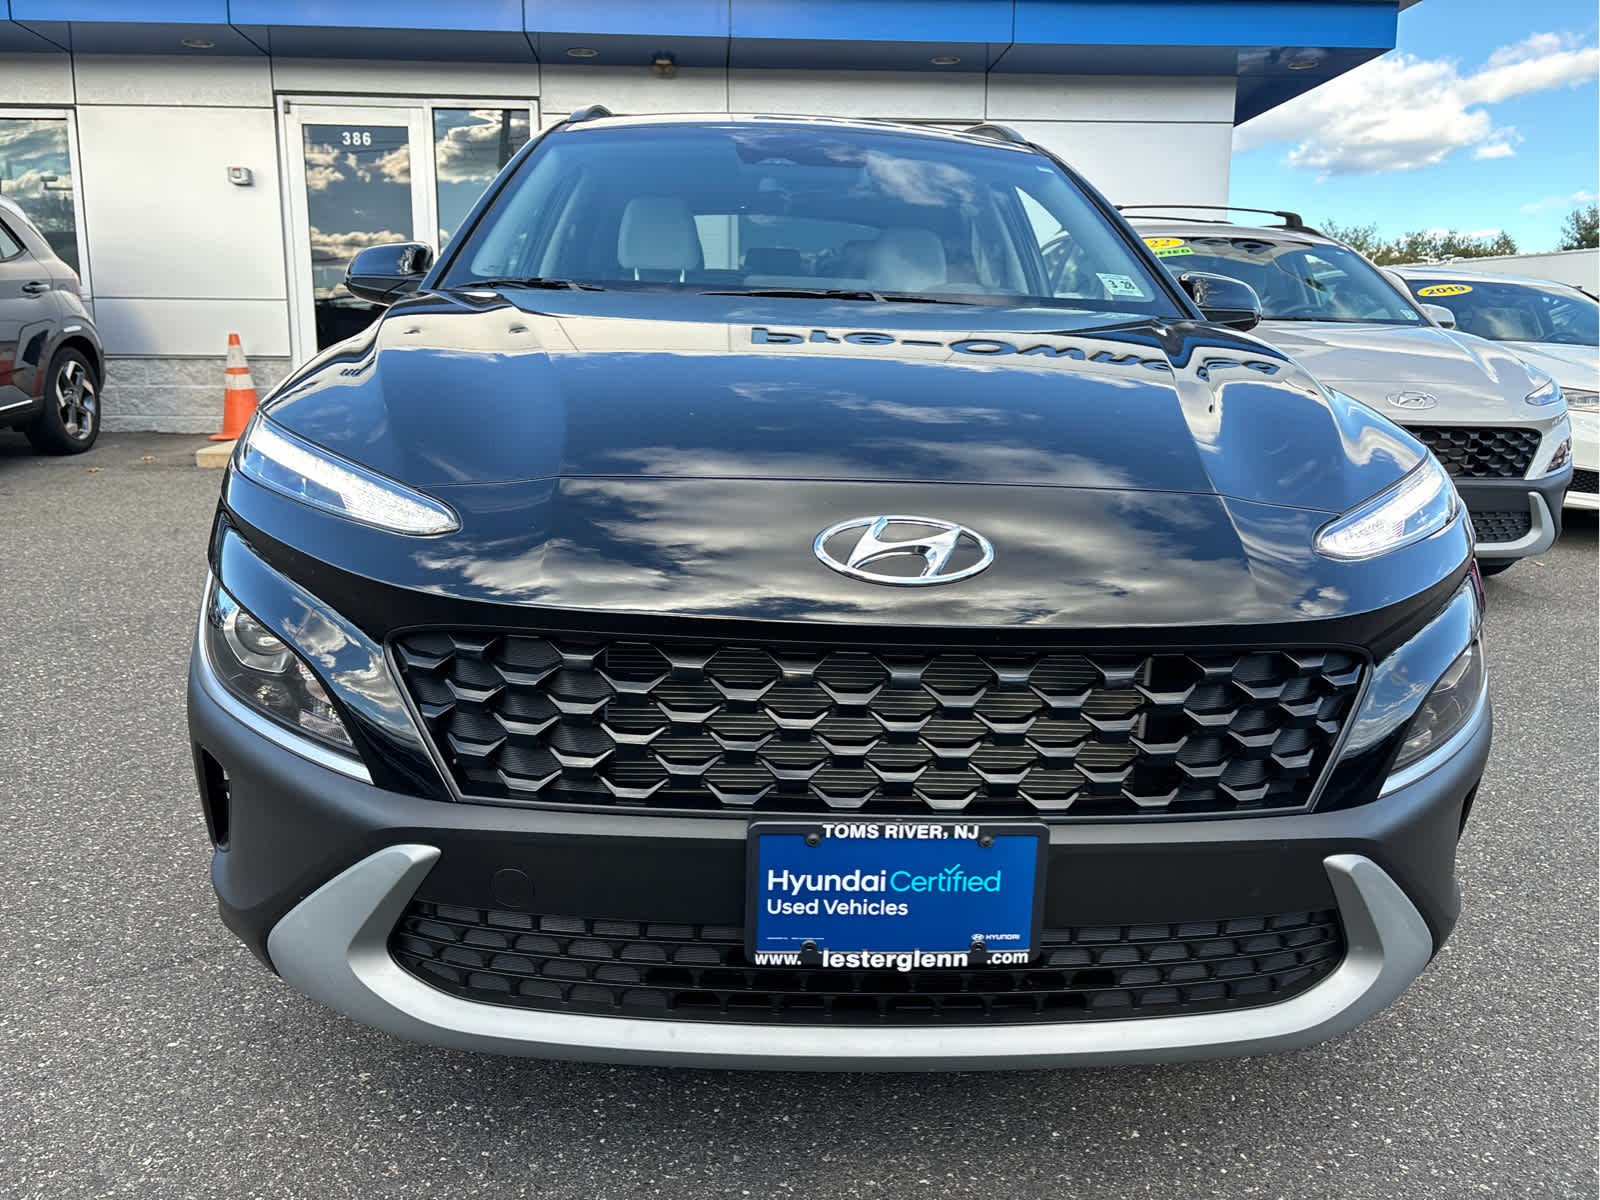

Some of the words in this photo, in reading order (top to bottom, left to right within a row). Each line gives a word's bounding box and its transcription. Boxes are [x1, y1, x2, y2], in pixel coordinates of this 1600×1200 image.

[342, 131, 372, 146] 386
[1426, 285, 1466, 295] 2019
[822, 824, 879, 839] TOMS
[885, 824, 949, 840] RIVER,
[954, 825, 979, 840] NJ
[767, 869, 887, 896] Hyundai
[890, 864, 1001, 892] Certified
[767, 898, 819, 915] Used
[823, 899, 909, 916] Vehicles
[985, 933, 1021, 941] HYUNDAI
[754, 953, 802, 965] www.
[821, 949, 969, 972] lesterglenn
[986, 951, 1029, 965] .com
